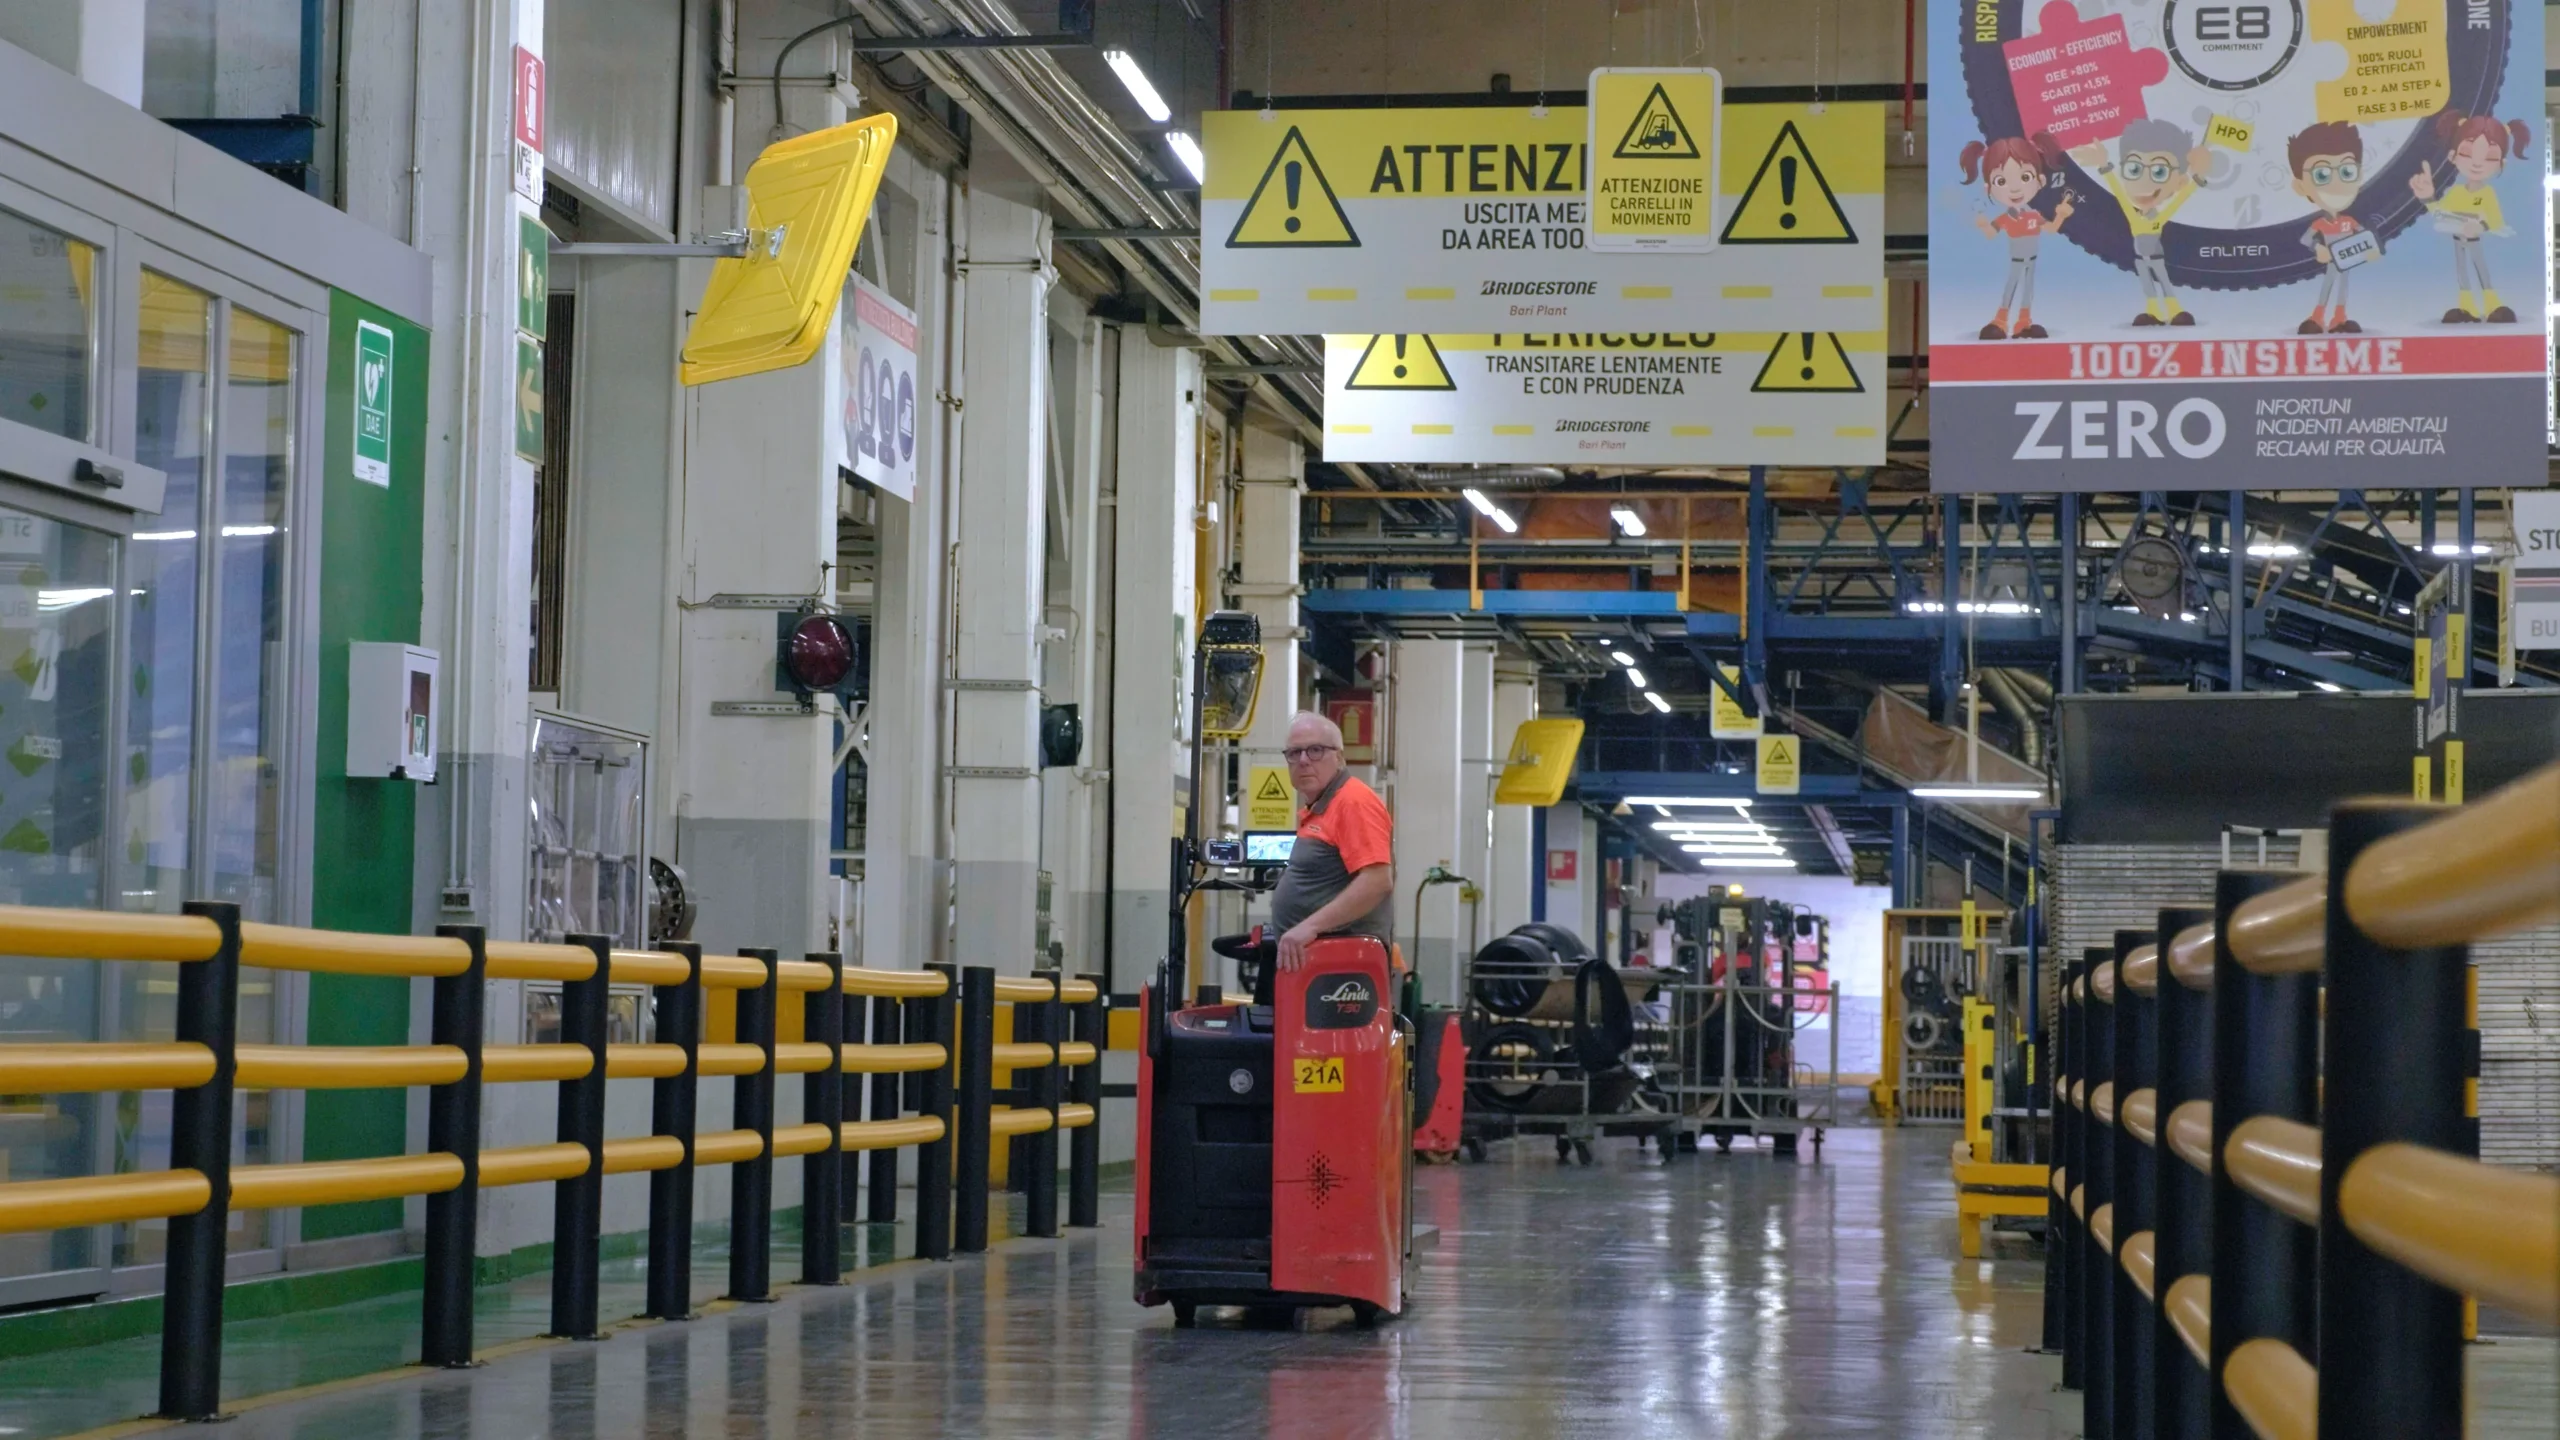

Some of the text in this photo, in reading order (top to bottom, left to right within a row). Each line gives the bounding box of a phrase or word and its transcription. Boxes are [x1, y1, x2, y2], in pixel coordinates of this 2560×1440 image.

[1976, 0, 1998, 42] RISP
[2196, 6, 2270, 40] E8
[2347, 20, 2428, 40] EMPOWERMENT
[2008, 46, 2057, 72] ECONOMY
[2065, 30, 2123, 57] EFFICIENCY
[2203, 43, 2264, 52] COMMITMENT
[2357, 48, 2422, 64] 100% RUOLI
[2045, 69, 2069, 83] OEE
[2356, 61, 2425, 76] CERTIFICATI
[2040, 84, 2081, 102] SCARTI
[2361, 85, 2368, 95] 2
[2381, 82, 2398, 93] AM
[2402, 79, 2431, 92] STEP
[2435, 79, 2441, 88] 4
[2052, 100, 2077, 116] HRD
[2357, 99, 2431, 115] FASE 3 B-ME
[2047, 114, 2080, 134] COSTI
[2215, 123, 2248, 142] HPO
[1601, 178, 1703, 193] ATTENZIONE
[1610, 197, 1693, 210] CARRELLI IN
[1464, 202, 1586, 224] USCITA ME
[1611, 213, 1691, 226] MOVIMENTO
[1442, 228, 1587, 250] DA AREA TOO
[2199, 244, 2270, 258] ENLITEN
[2337, 240, 2373, 261] SKILL
[1480, 280, 1598, 295] BRIDGESTONE
[1509, 304, 1568, 316] Bari Plant
[1486, 356, 1722, 374] TRANSITARE LENTAMENTE
[2069, 338, 2403, 379] 100% INSIEME
[1524, 377, 1685, 395] E CON PRUDENZA
[2255, 398, 2352, 416] INFORTUNI
[365, 413, 380, 435] DAE
[1555, 419, 1651, 433] BRIDGESTONE
[2012, 397, 2227, 460] ZERO
[2255, 416, 2448, 436] INCIDENTI AMBIENTALI
[1578, 439, 1626, 450] Bari Plant
[2255, 433, 2446, 457] RECLAMI PER QUALITÀ
[1320, 981, 1370, 1002] Linde
[1302, 1066, 1342, 1084] 21A
